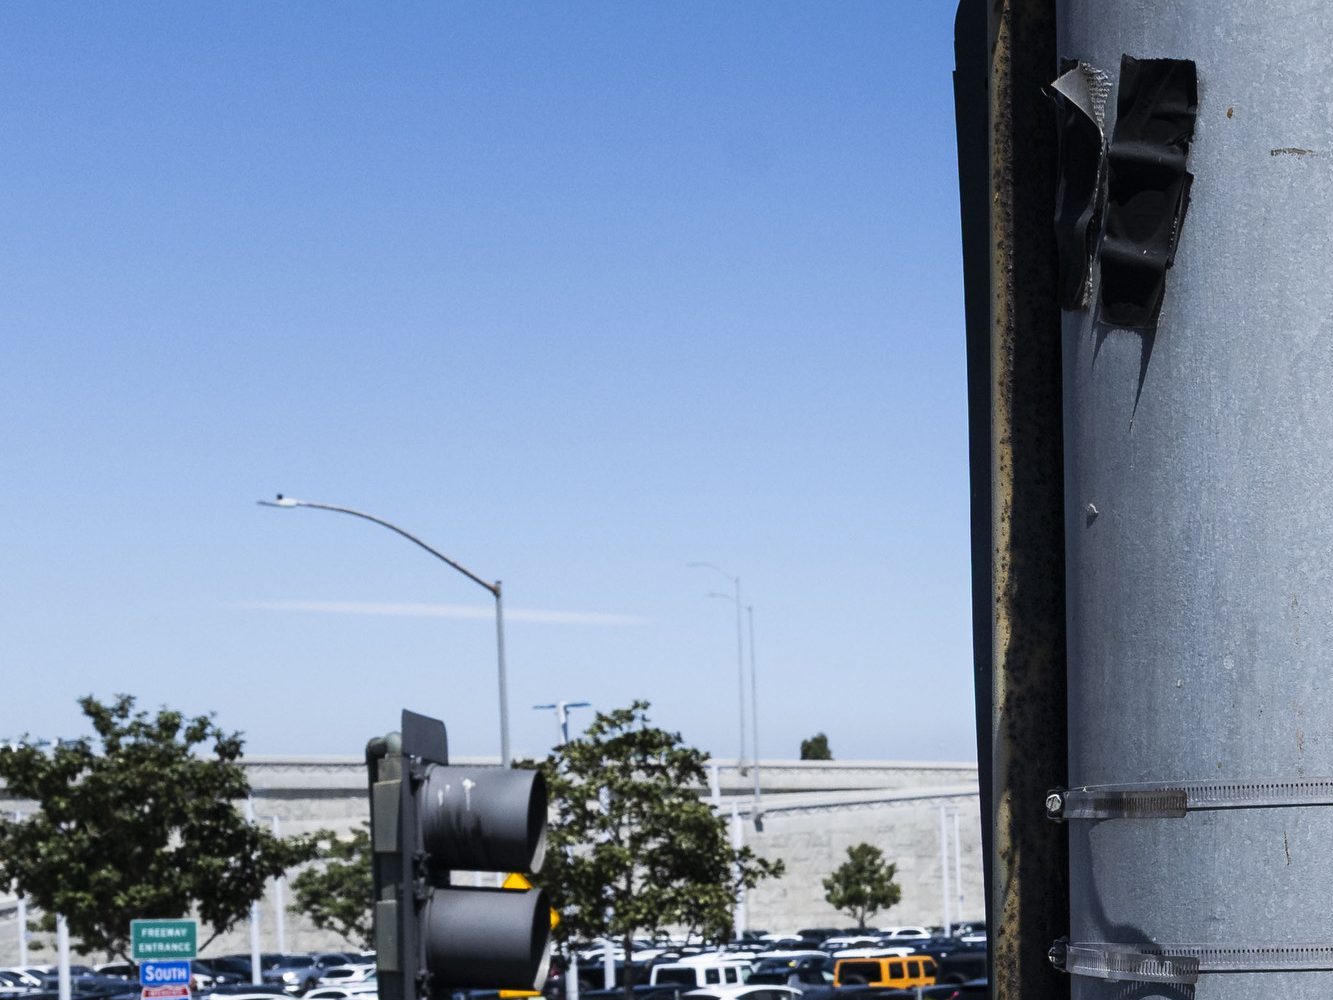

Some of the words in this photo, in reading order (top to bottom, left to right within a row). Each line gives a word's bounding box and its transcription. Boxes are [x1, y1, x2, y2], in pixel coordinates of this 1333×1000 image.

[141, 927, 188, 938] FREEWAY
[139, 942, 191, 953] ENTRANCE
[144, 964, 187, 982] SOUTH
